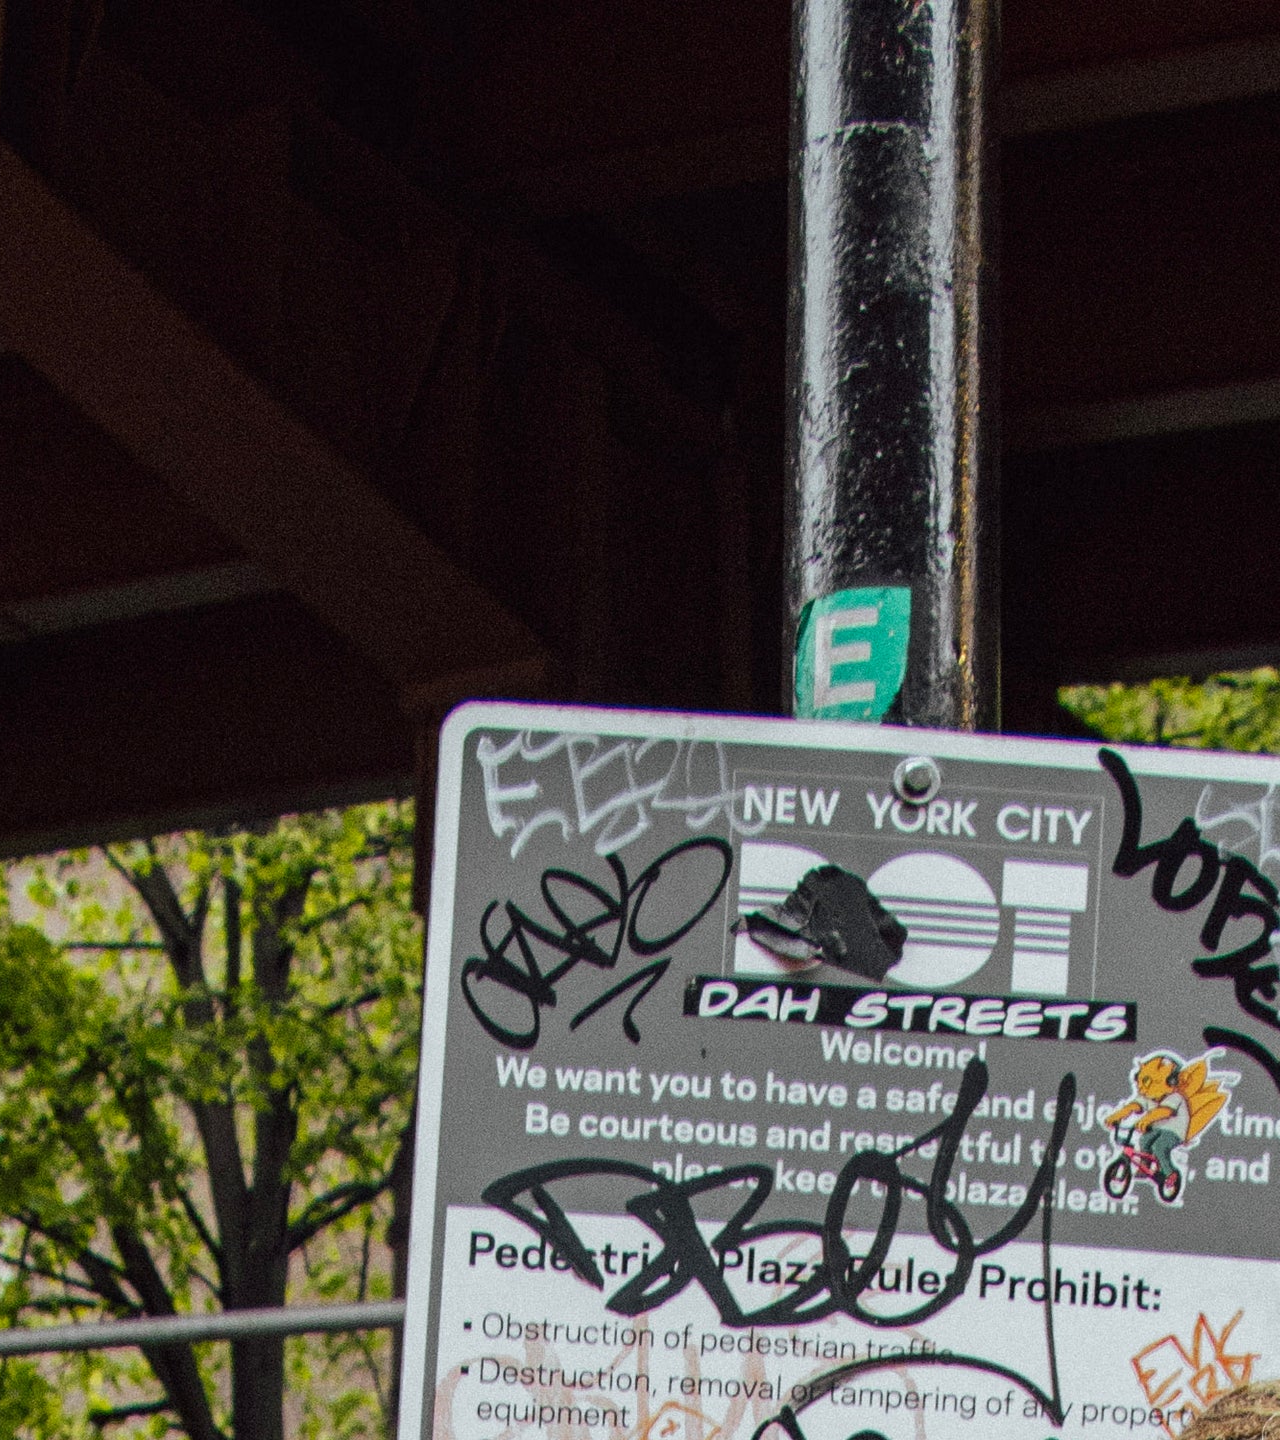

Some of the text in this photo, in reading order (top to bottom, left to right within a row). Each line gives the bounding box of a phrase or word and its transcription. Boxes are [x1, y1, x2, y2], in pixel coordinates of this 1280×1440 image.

[743, 785, 1093, 845] NEW YORK CITY
[698, 980, 1127, 1041] DAH STREETS
[821, 1030, 988, 1069] Welcome!
[496, 1055, 548, 1089] We
[556, 1065, 642, 1095] want
[650, 1072, 712, 1102] you
[721, 1072, 758, 1102] to
[766, 1071, 848, 1108] have
[857, 1085, 877, 1110] a
[525, 1102, 570, 1136] Be
[578, 1113, 758, 1148] courteous
[766, 1121, 831, 1153] and
[839, 1129, 1021, 1166] respetful
[1205, 1151, 1271, 1184] and
[776, 1158, 860, 1196] kee
[979, 1263, 1162, 1312] Prohibit:
[481, 1312, 655, 1348] Obstruction
[663, 1323, 695, 1350] of
[700, 1326, 856, 1360] pedestrian
[476, 1399, 631, 1434] equipment
[479, 1357, 658, 1398] Destruction,
[668, 1374, 782, 1401] removal
[830, 1380, 978, 1421] tampering
[985, 1388, 1016, 1416] of
[1081, 1400, 1199, 1436] propert
